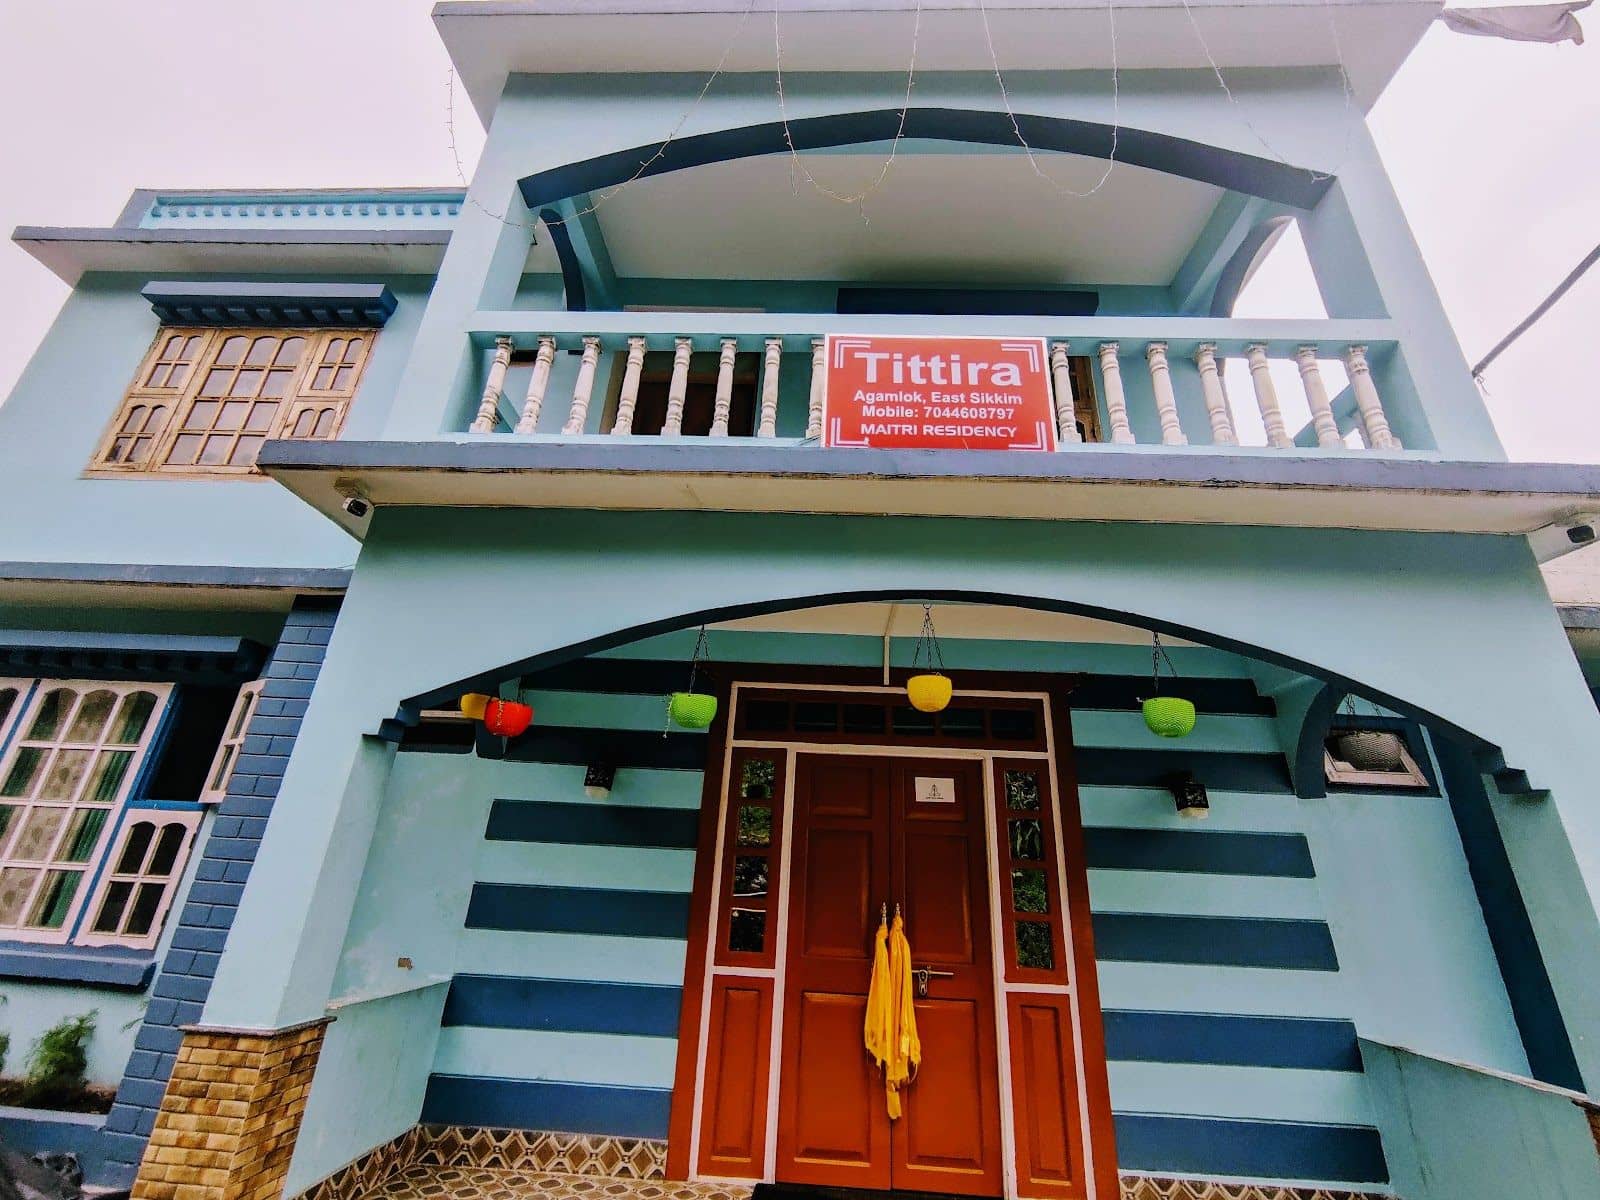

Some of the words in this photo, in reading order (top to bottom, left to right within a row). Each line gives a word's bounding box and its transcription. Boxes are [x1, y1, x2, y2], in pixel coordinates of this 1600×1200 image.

[854, 352, 1022, 386] Tittira
[854, 390, 926, 405] Agamlok,
[931, 391, 966, 404] East
[970, 392, 1022, 405] Sikkim
[862, 405, 918, 418] Mobile:
[924, 407, 1014, 420] 7044608797
[860, 423, 917, 435] MAITRI
[923, 424, 1016, 438] RESIDENCY
